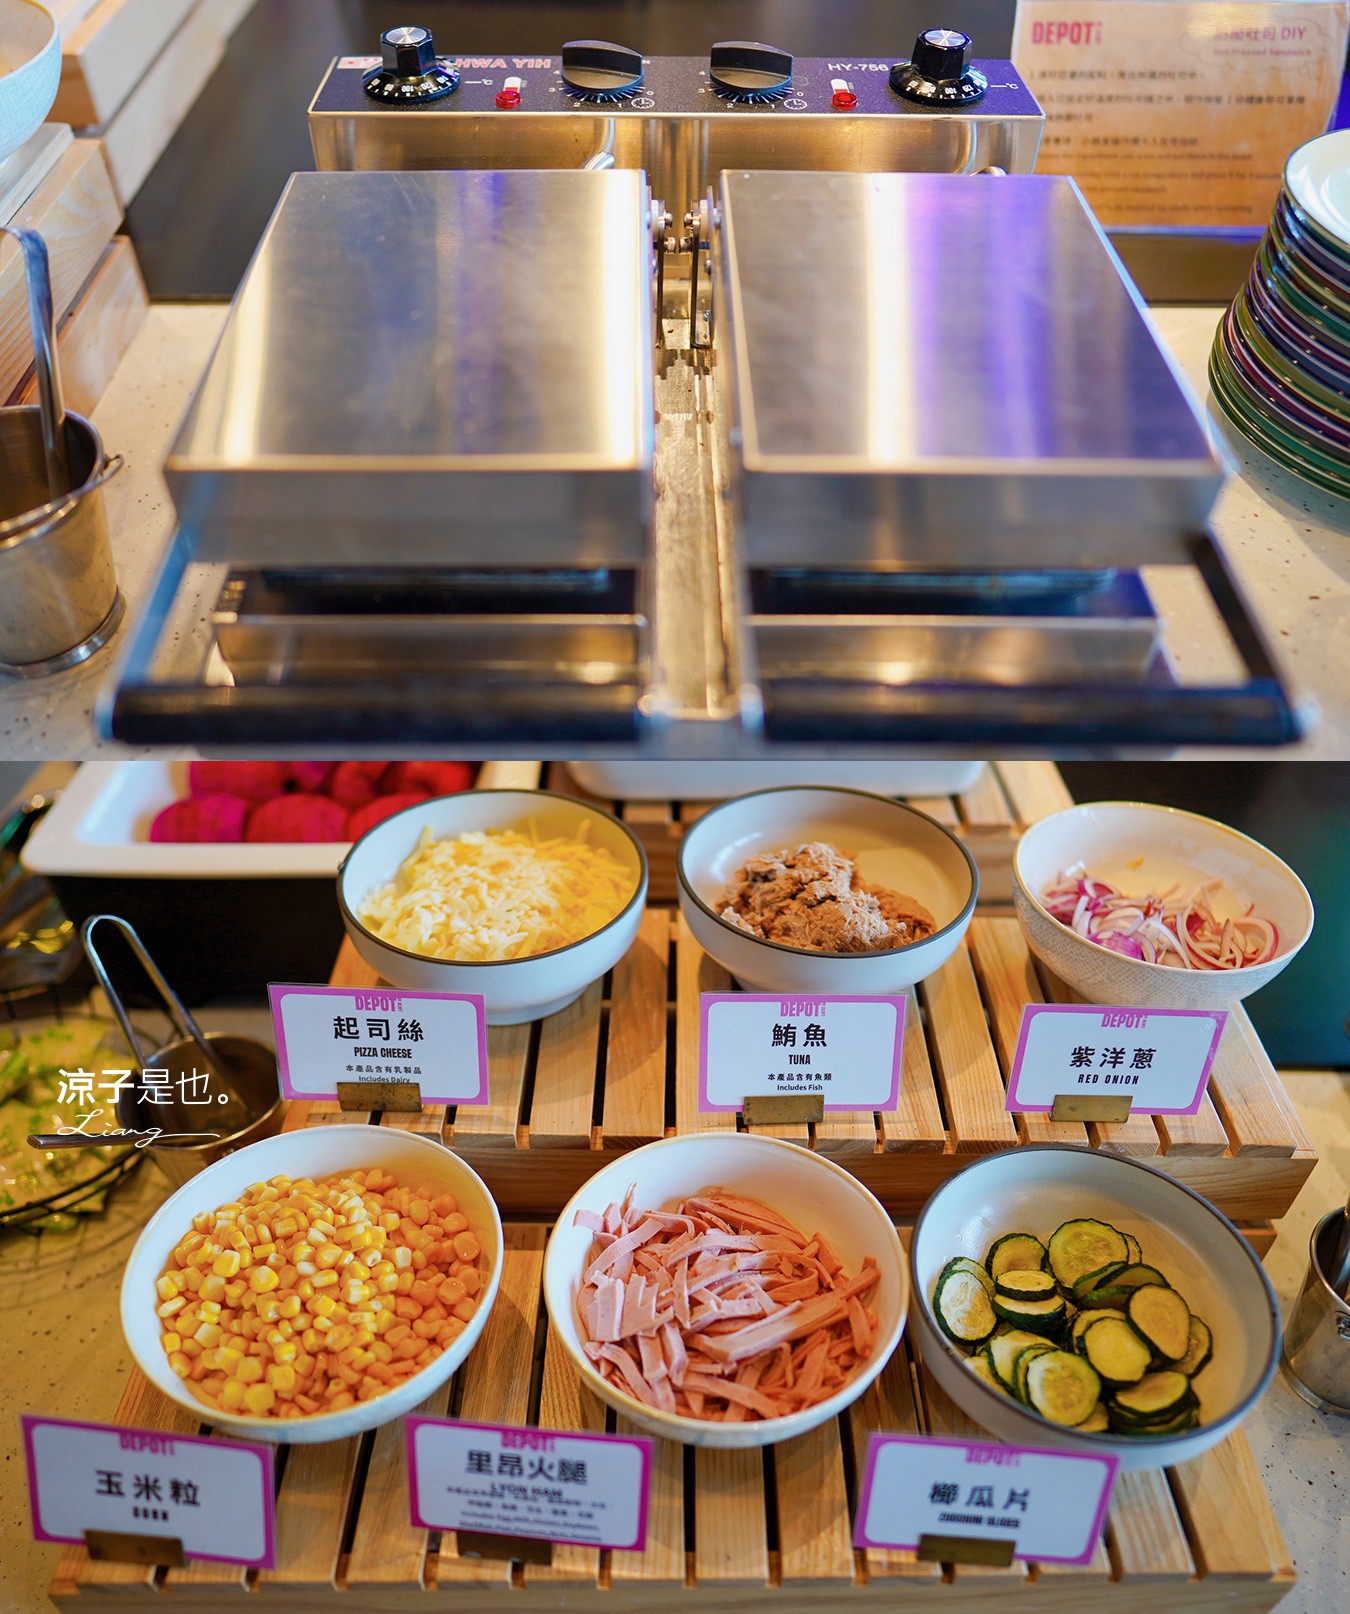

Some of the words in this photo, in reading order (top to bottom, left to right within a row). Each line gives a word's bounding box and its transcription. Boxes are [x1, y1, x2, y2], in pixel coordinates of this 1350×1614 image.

[1031, 21, 1095, 45] DEPOT
[1281, 26, 1306, 41] DIY
[455, 58, 507, 69] HWA
[512, 58, 551, 69] YIH
[827, 63, 889, 72] HY-756
[354, 996, 397, 1012] DEPOT
[780, 1001, 820, 1017] DEPOT
[1101, 1013, 1142, 1028] DEPOT
[333, 1016, 424, 1042] 起司絲
[771, 1023, 828, 1047] 鮪魚
[354, 1046, 378, 1058] PIZZA
[380, 1047, 412, 1059] CHEESE
[788, 1054, 811, 1065] TUNA
[345, 1064, 422, 1075] 本產品含有乳製品
[767, 1073, 832, 1081] 本產品含有魚類
[358, 1075, 390, 1083] Includes
[390, 1076, 411, 1084] Dairy
[1078, 1074, 1099, 1084] RED
[1104, 1075, 1139, 1085] ONION
[466, 1449, 588, 1485] 里昂火腿
[96, 1469, 200, 1506] 玉米粒
